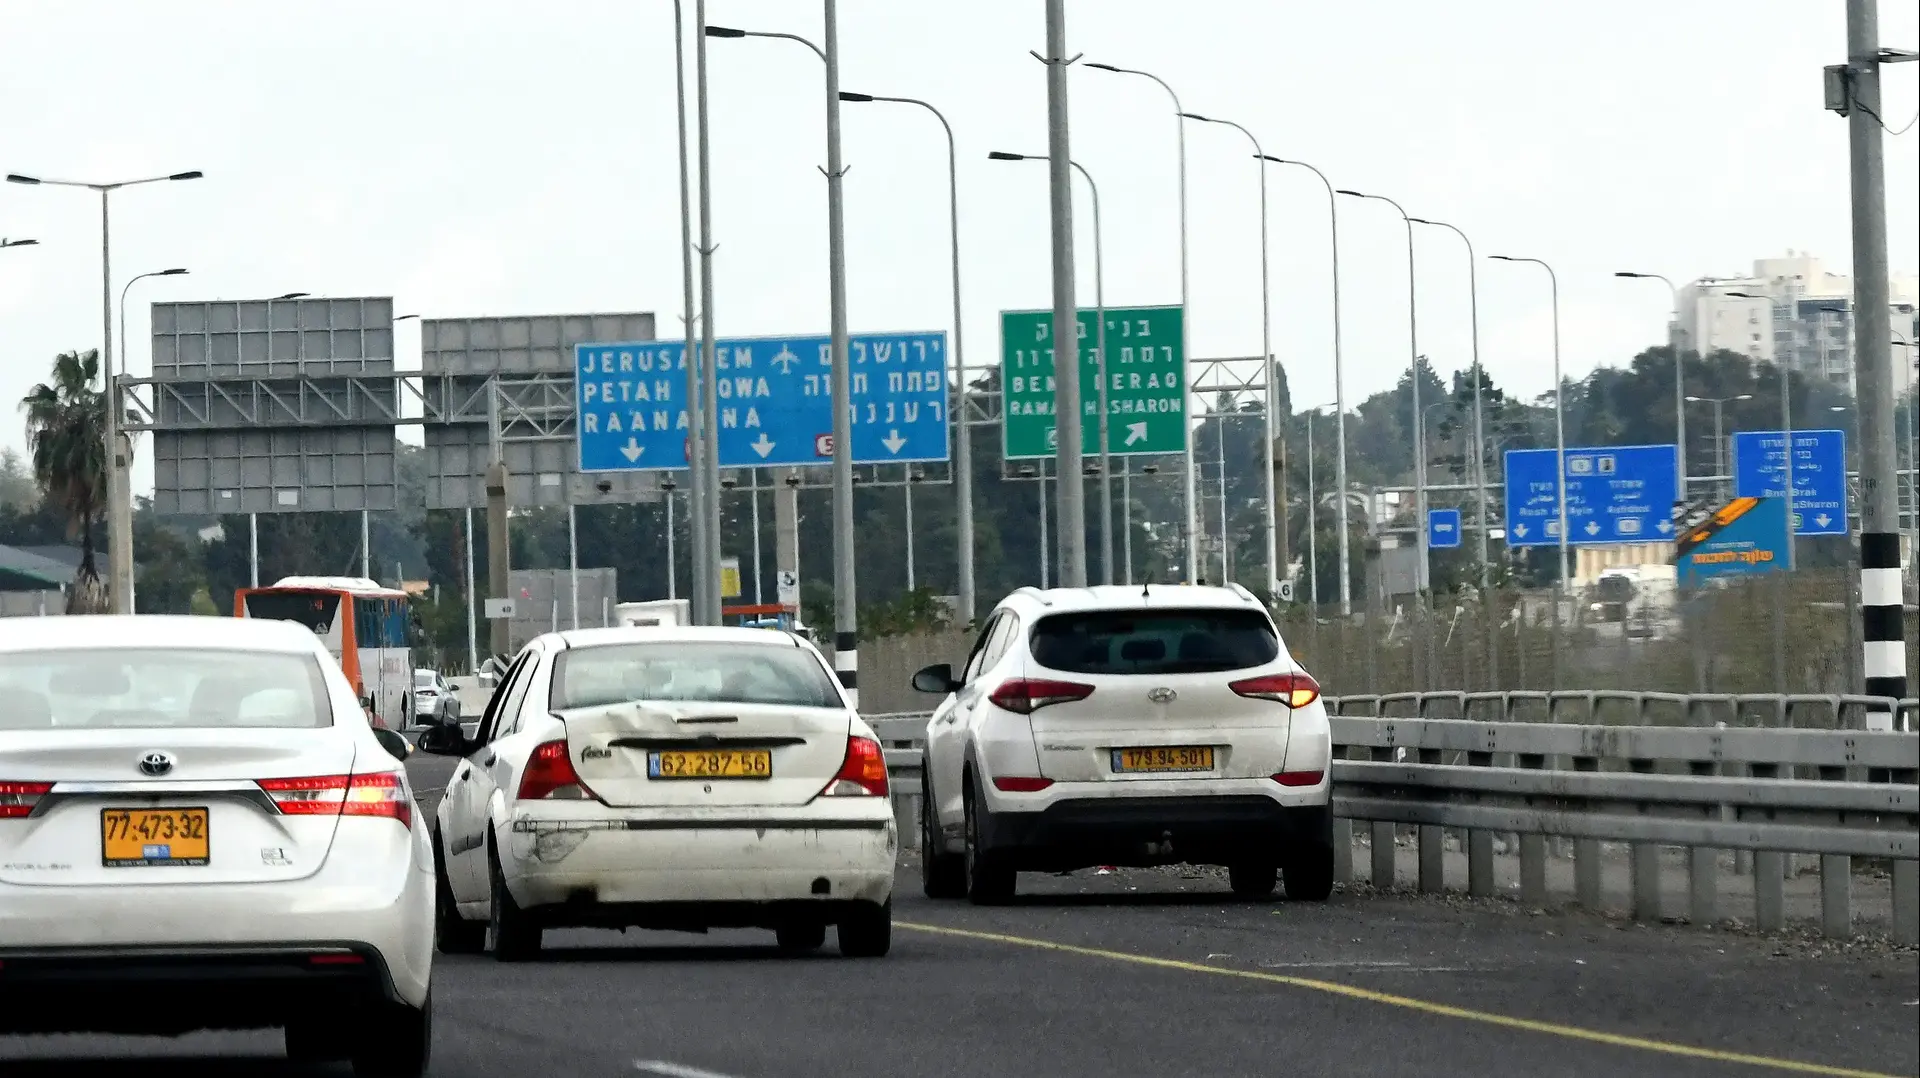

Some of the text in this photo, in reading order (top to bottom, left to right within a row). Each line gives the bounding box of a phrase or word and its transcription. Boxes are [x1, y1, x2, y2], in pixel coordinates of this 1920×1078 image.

[1036, 320, 1151, 341] בני בק
[583, 347, 752, 373] JERUSAEM
[1120, 346, 1172, 363] רמת
[583, 379, 671, 403] PETAH
[804, 370, 941, 396] פתח תוה
